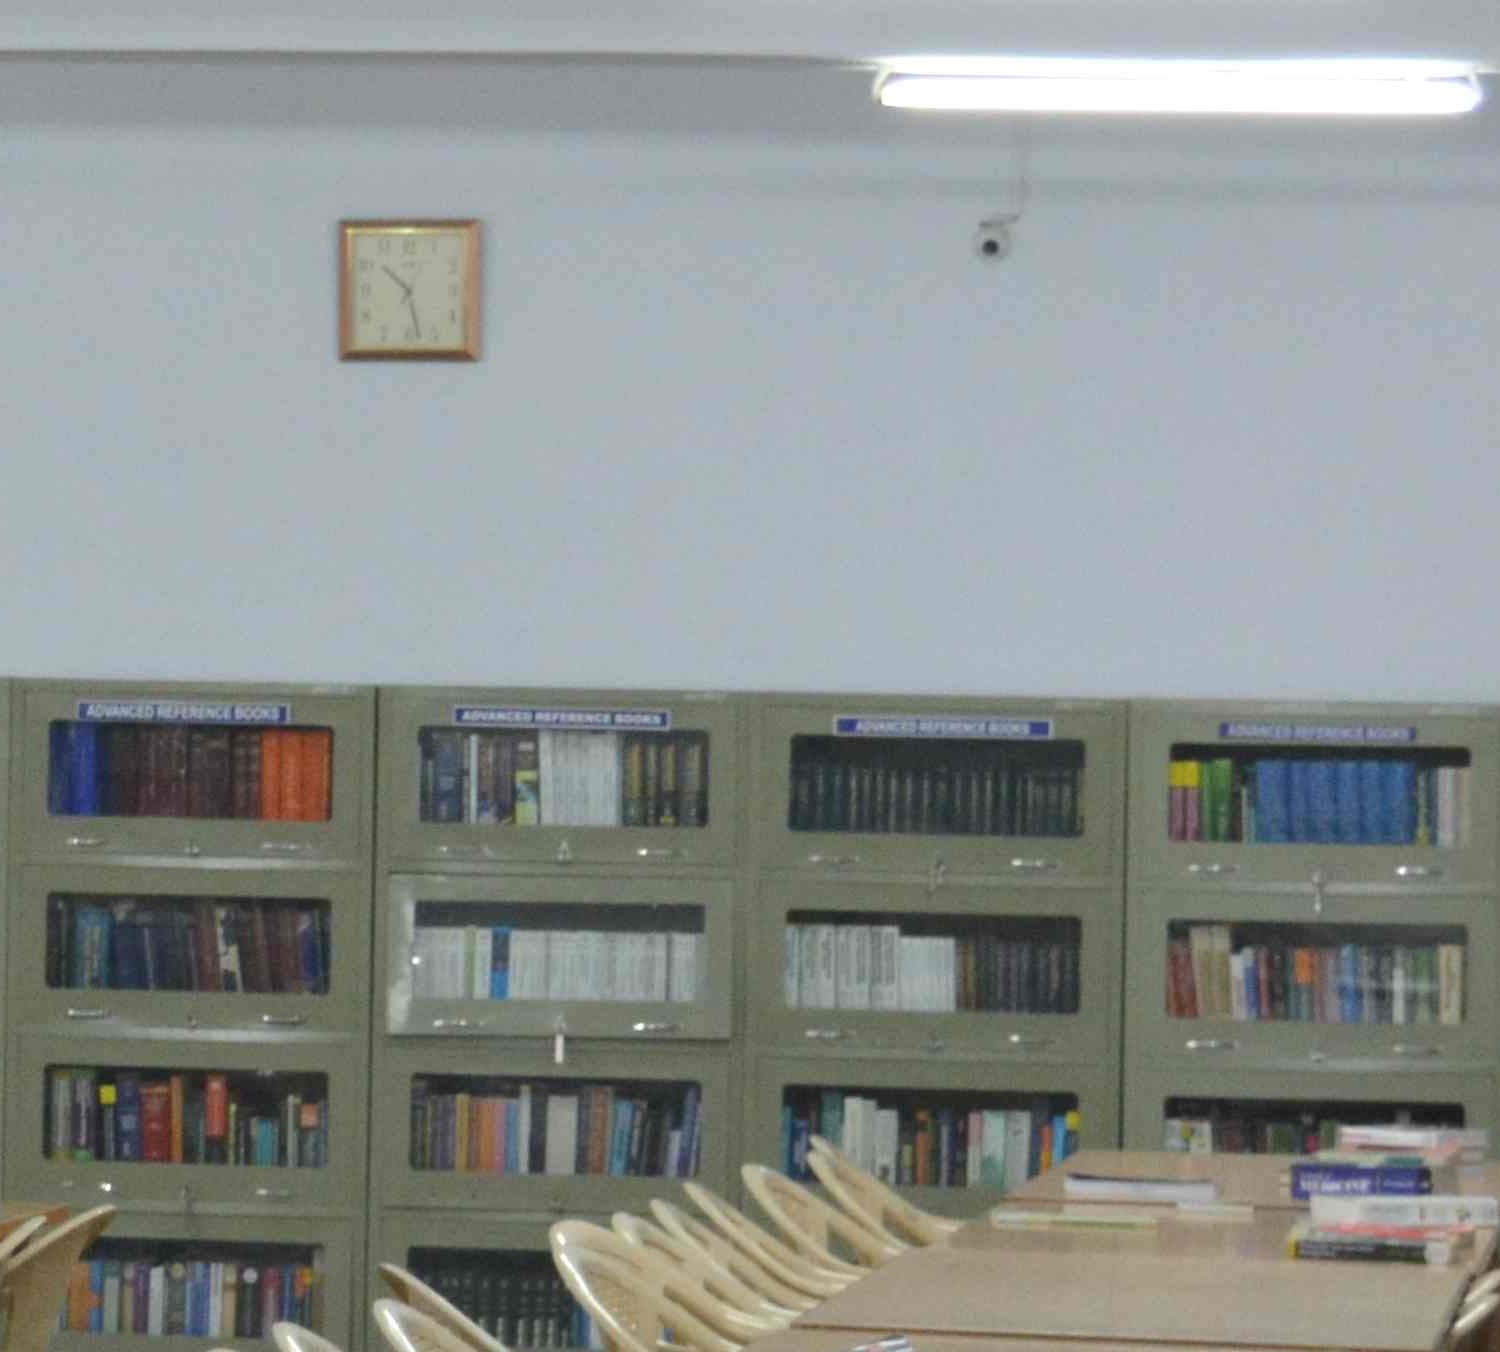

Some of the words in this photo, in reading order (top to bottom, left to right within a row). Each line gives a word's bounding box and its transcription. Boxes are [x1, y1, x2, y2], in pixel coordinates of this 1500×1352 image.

[87, 703, 153, 719] ADVANCED
[157, 704, 232, 720] REFERENCE
[235, 705, 280, 721] BOOKS
[462, 710, 532, 723] ADVANCED
[535, 711, 611, 725] REFERENCE
[615, 713, 662, 726] BOOKS
[856, 719, 916, 734] ADVANCED
[920, 720, 986, 735] REFERENCE
[989, 721, 1030, 736] BOOKS
[1229, 723, 1291, 738] ADVANCED
[1294, 725, 1364, 740] REFERENCE
[1367, 726, 1409, 740] BOOKS
